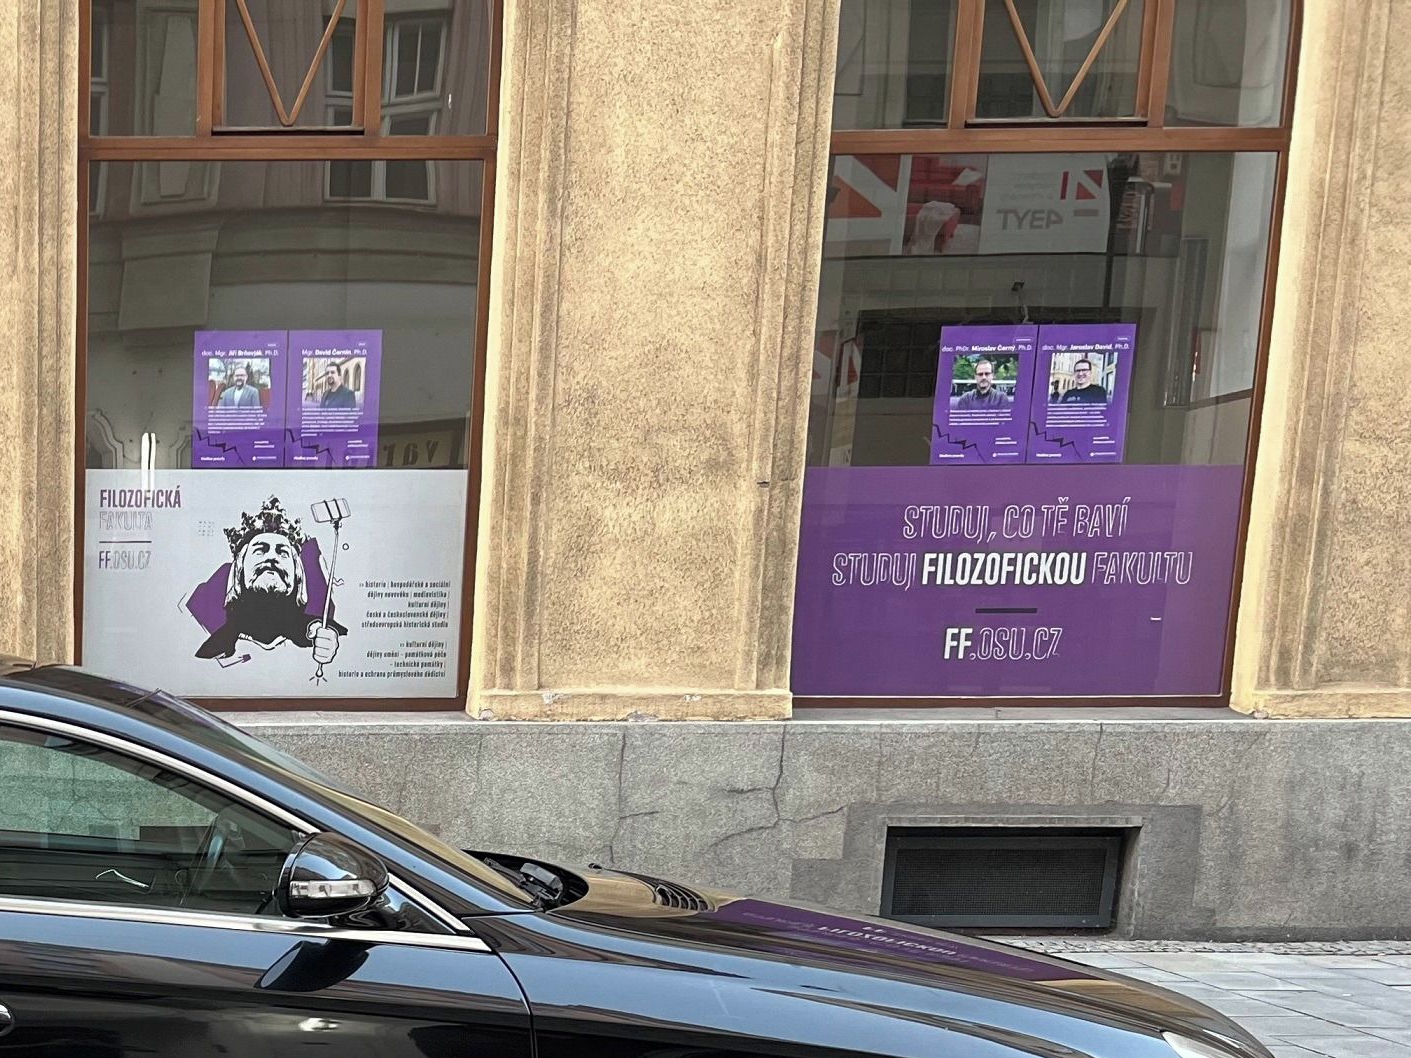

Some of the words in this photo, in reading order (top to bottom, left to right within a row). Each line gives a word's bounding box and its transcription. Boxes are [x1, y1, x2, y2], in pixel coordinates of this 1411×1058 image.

[971, 344, 996, 352] Miroslav
[1070, 343, 1094, 351] Jaroslav
[100, 485, 181, 508] FILOZOFICKÁ
[99, 511, 153, 530] FAKULTA
[902, 504, 997, 544] STUDUJ,
[1002, 505, 1035, 539] CO
[1041, 496, 1069, 537] TĚ
[1073, 496, 1131, 538] BAVÍ
[98, 550, 152, 570] FF.OSU.CZ
[831, 552, 917, 592] STUDUJ
[921, 552, 1087, 585] FILOZOFICKOU
[1091, 551, 1194, 585] FAKULTU
[431, 620, 448, 628] studia
[943, 627, 1063, 661] FF.OSU.CZ
